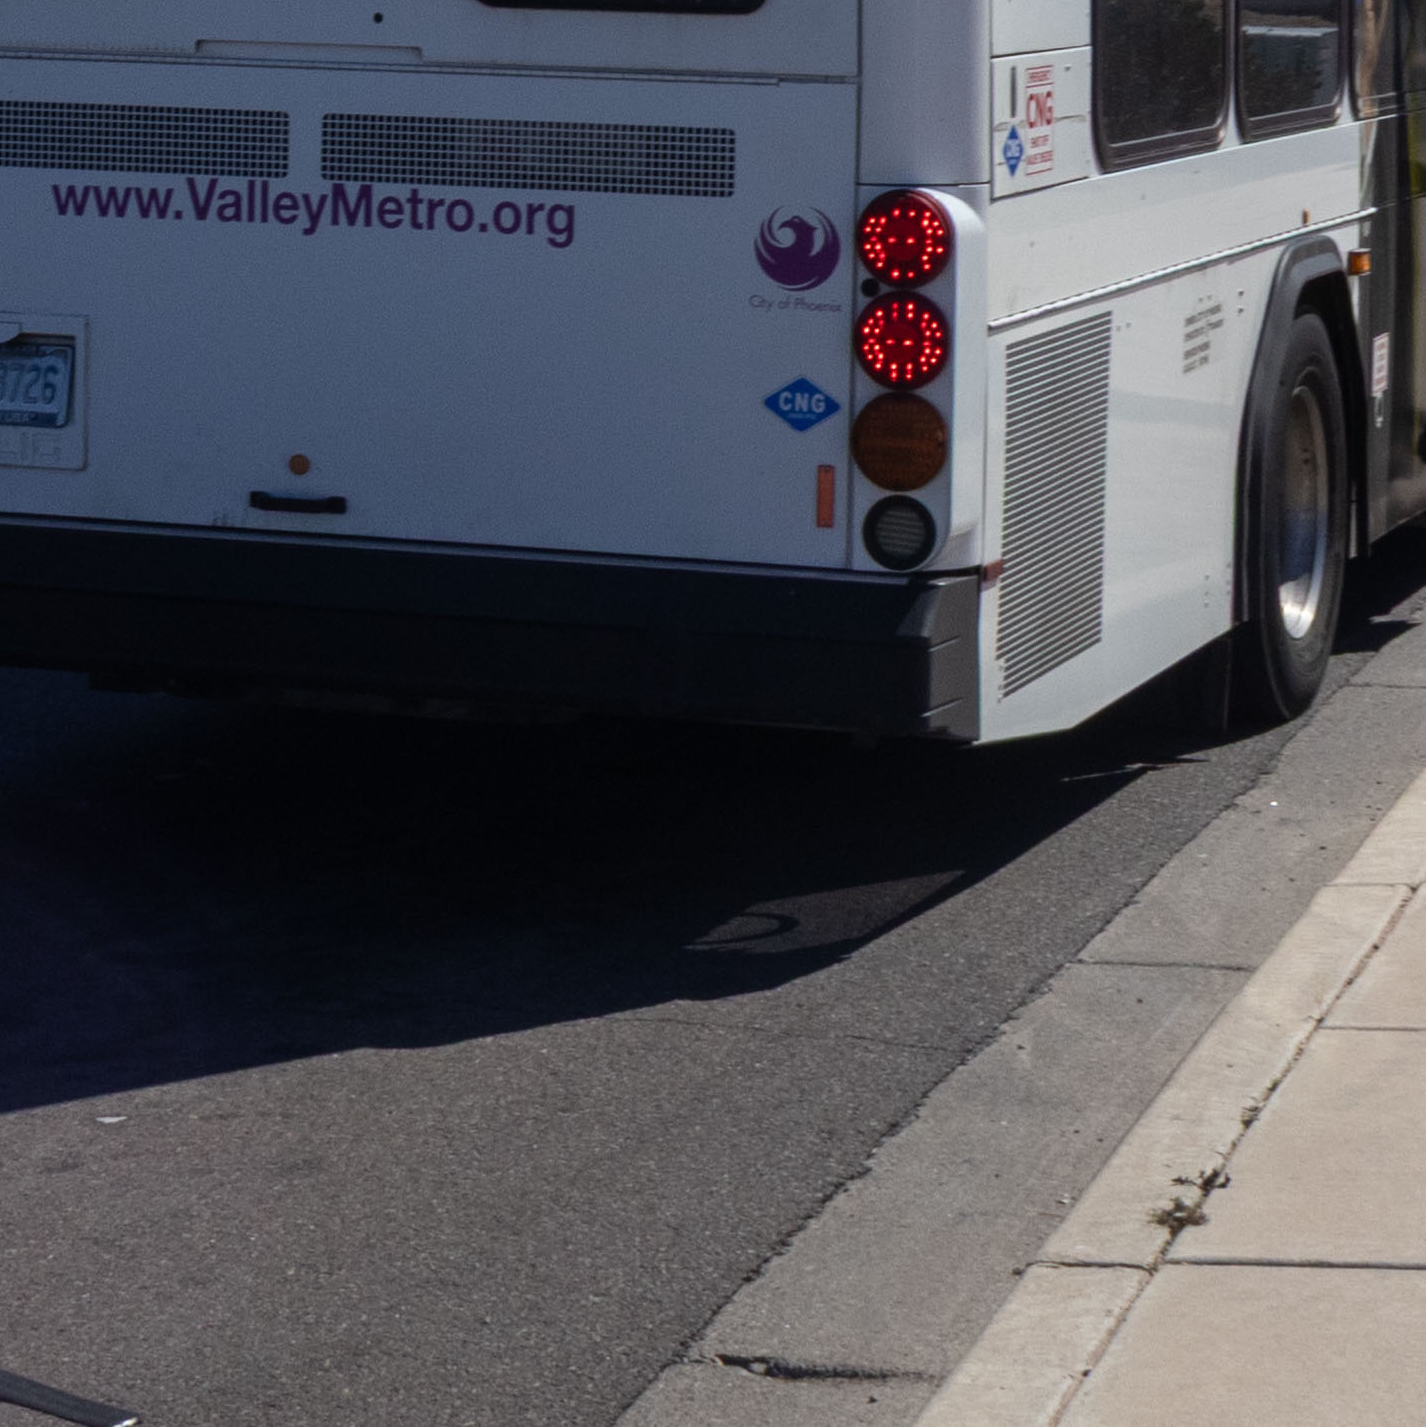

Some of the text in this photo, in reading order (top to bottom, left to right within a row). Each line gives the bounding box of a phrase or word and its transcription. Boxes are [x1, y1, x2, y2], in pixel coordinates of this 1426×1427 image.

[1026, 91, 1053, 128] CNG
[52, 177, 575, 248] www.ValleyMetro.org
[779, 391, 826, 413] CNG
